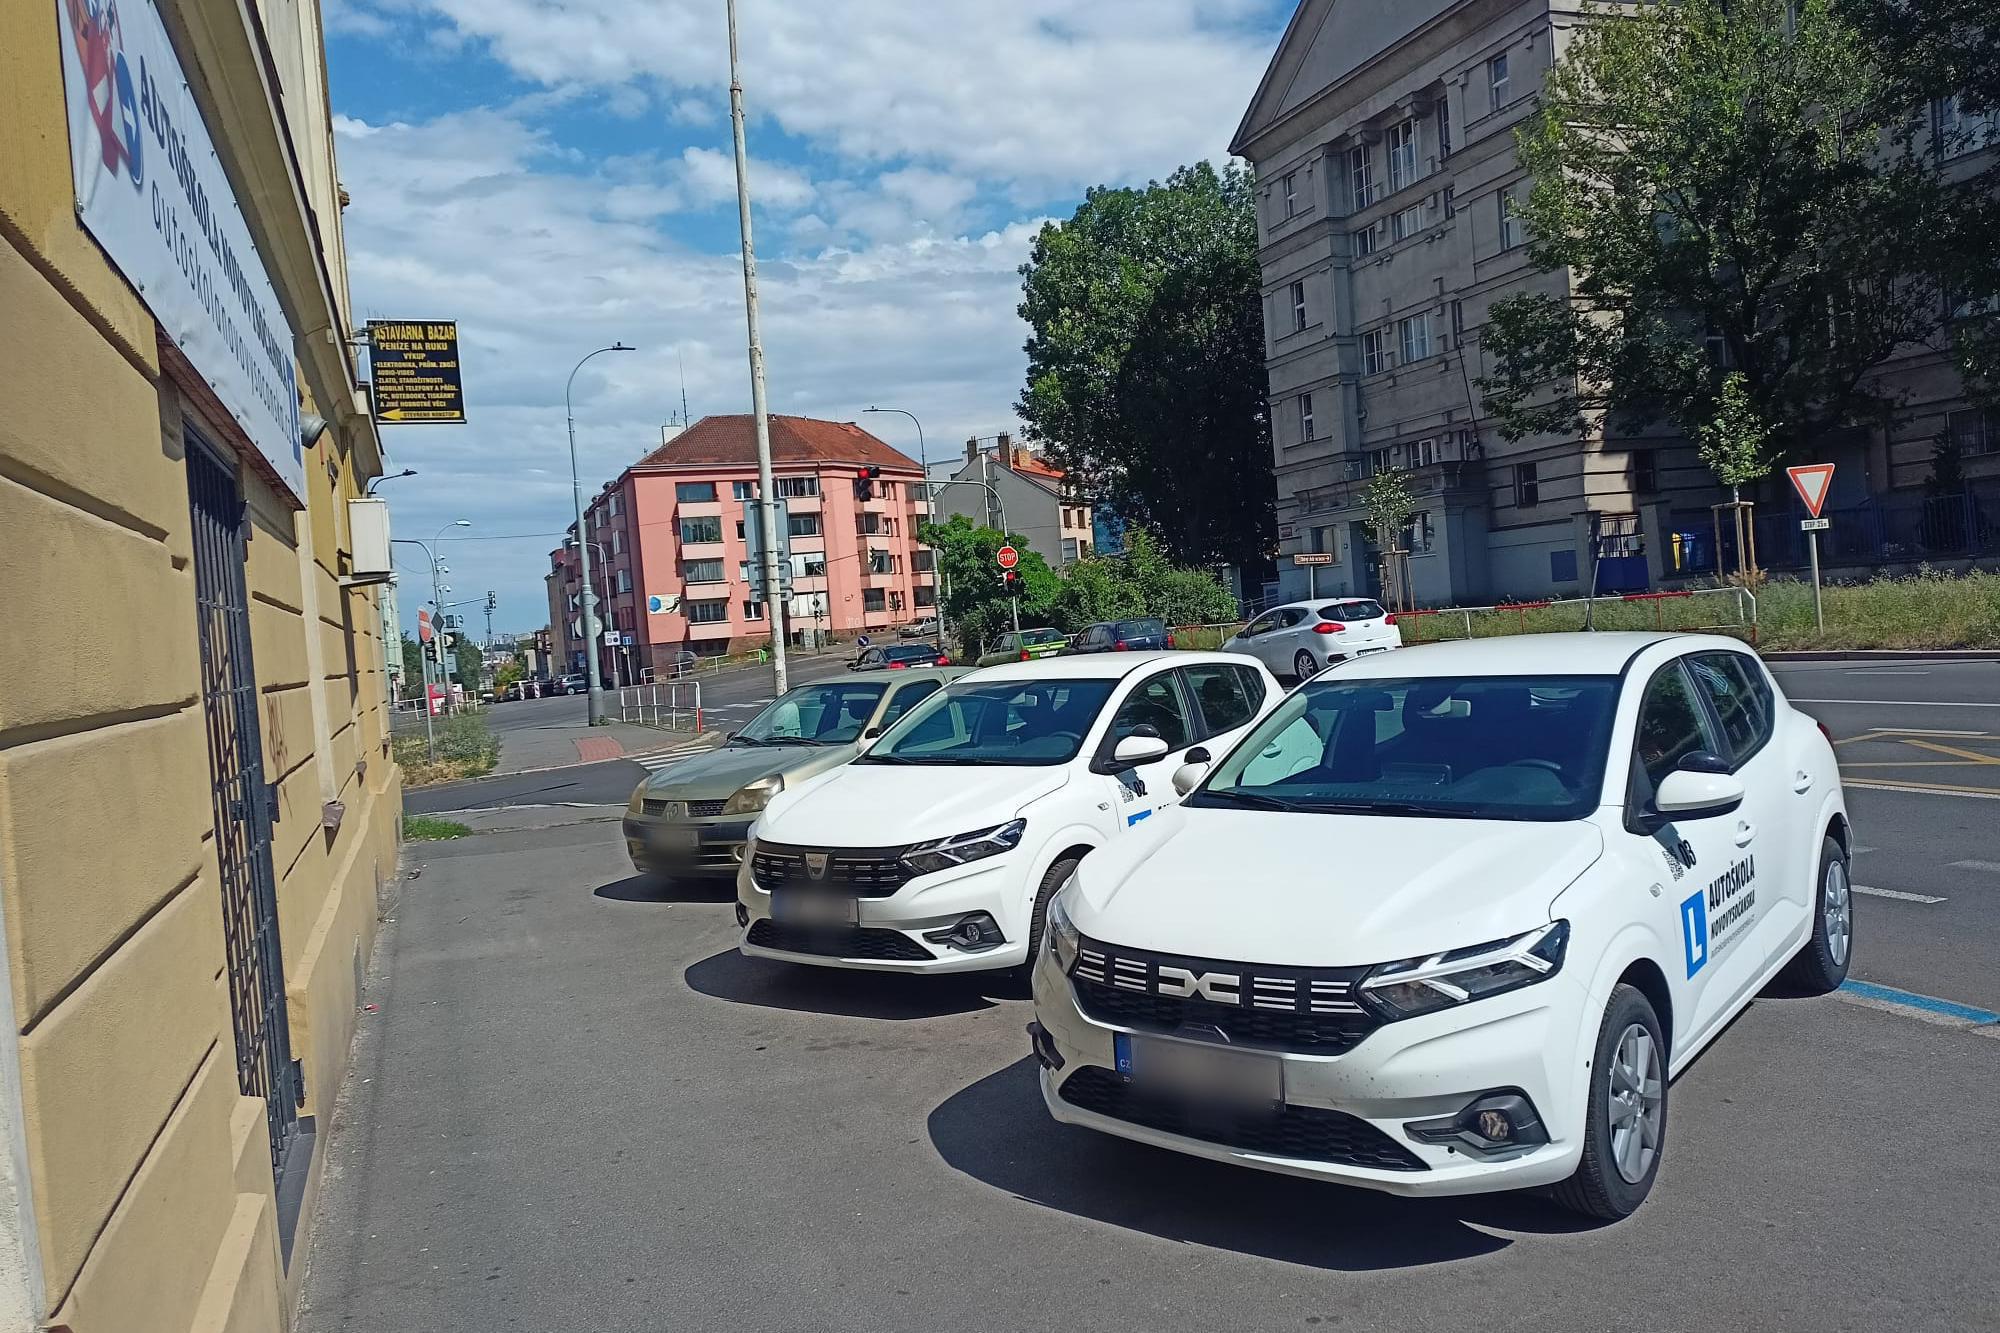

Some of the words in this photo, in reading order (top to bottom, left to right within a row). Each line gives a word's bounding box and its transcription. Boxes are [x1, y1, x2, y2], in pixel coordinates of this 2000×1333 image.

[140, 55, 222, 267] AUTOŠKOLA
[370, 323, 424, 340] ASTAVÁRNA
[427, 325, 456, 340] BAZAR
[380, 342, 410, 350] PENÍZE
[425, 342, 448, 350] RUKU
[402, 352, 426, 360] VÝKUP
[1000, 553, 1016, 562] STOP
[1678, 839, 1697, 870] 03
[1709, 854, 1755, 912] AUTOŠKOLA
[1119, 1058, 1132, 1069] CZ
